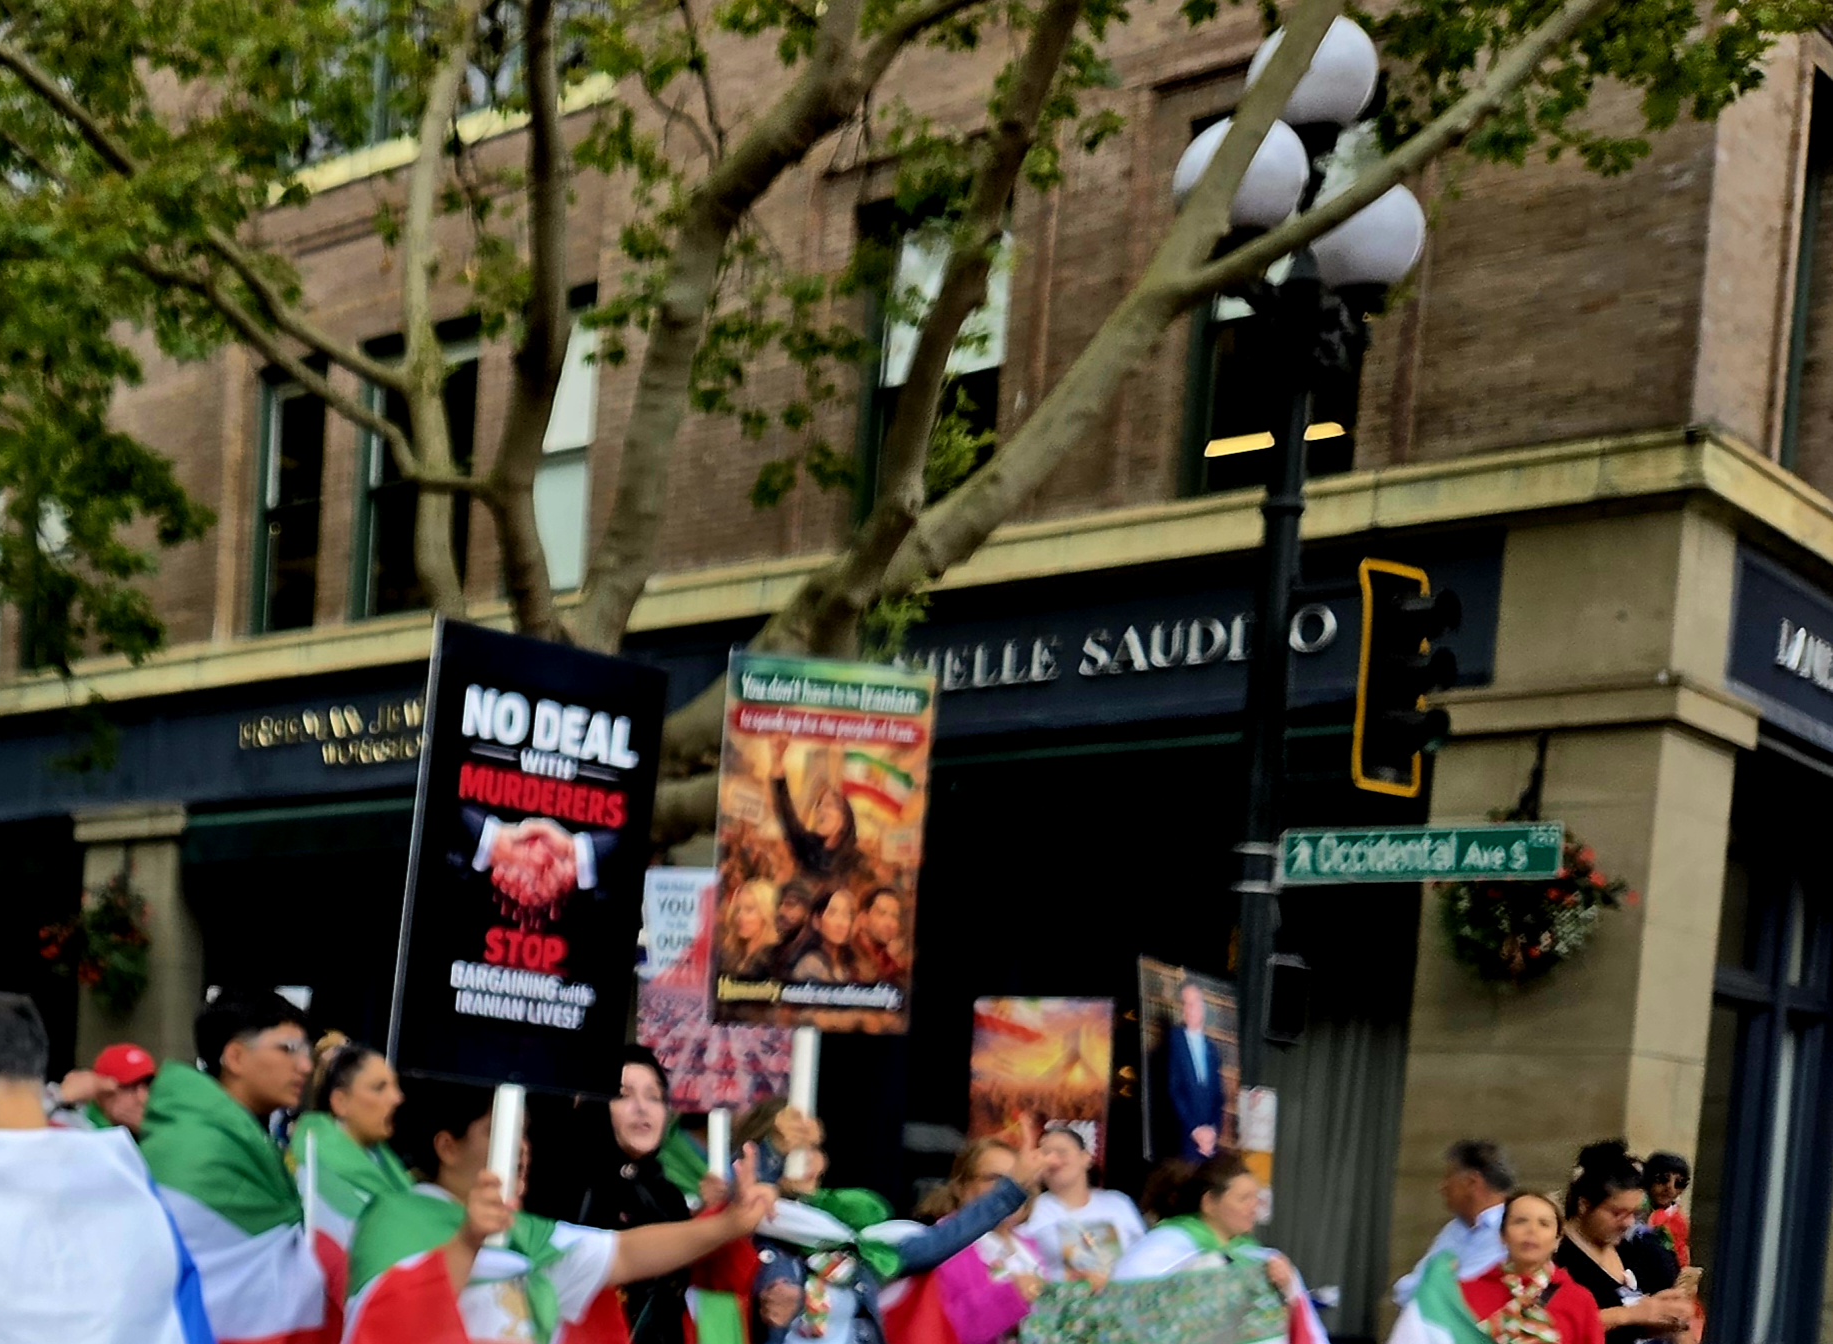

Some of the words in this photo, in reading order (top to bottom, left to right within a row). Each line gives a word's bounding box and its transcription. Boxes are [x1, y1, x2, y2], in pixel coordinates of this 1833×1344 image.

[1078, 603, 1337, 676] SAUDIO
[462, 683, 531, 745] NO
[532, 698, 640, 769] DEAL
[459, 762, 628, 828] MURDERERS
[1317, 832, 1457, 872] Occidental
[1461, 840, 1506, 870] Ave
[1509, 839, 1529, 870] S
[484, 926, 568, 970] STOP
[450, 960, 563, 1001] BARGAINING
[455, 989, 527, 1022] IRANIAN
